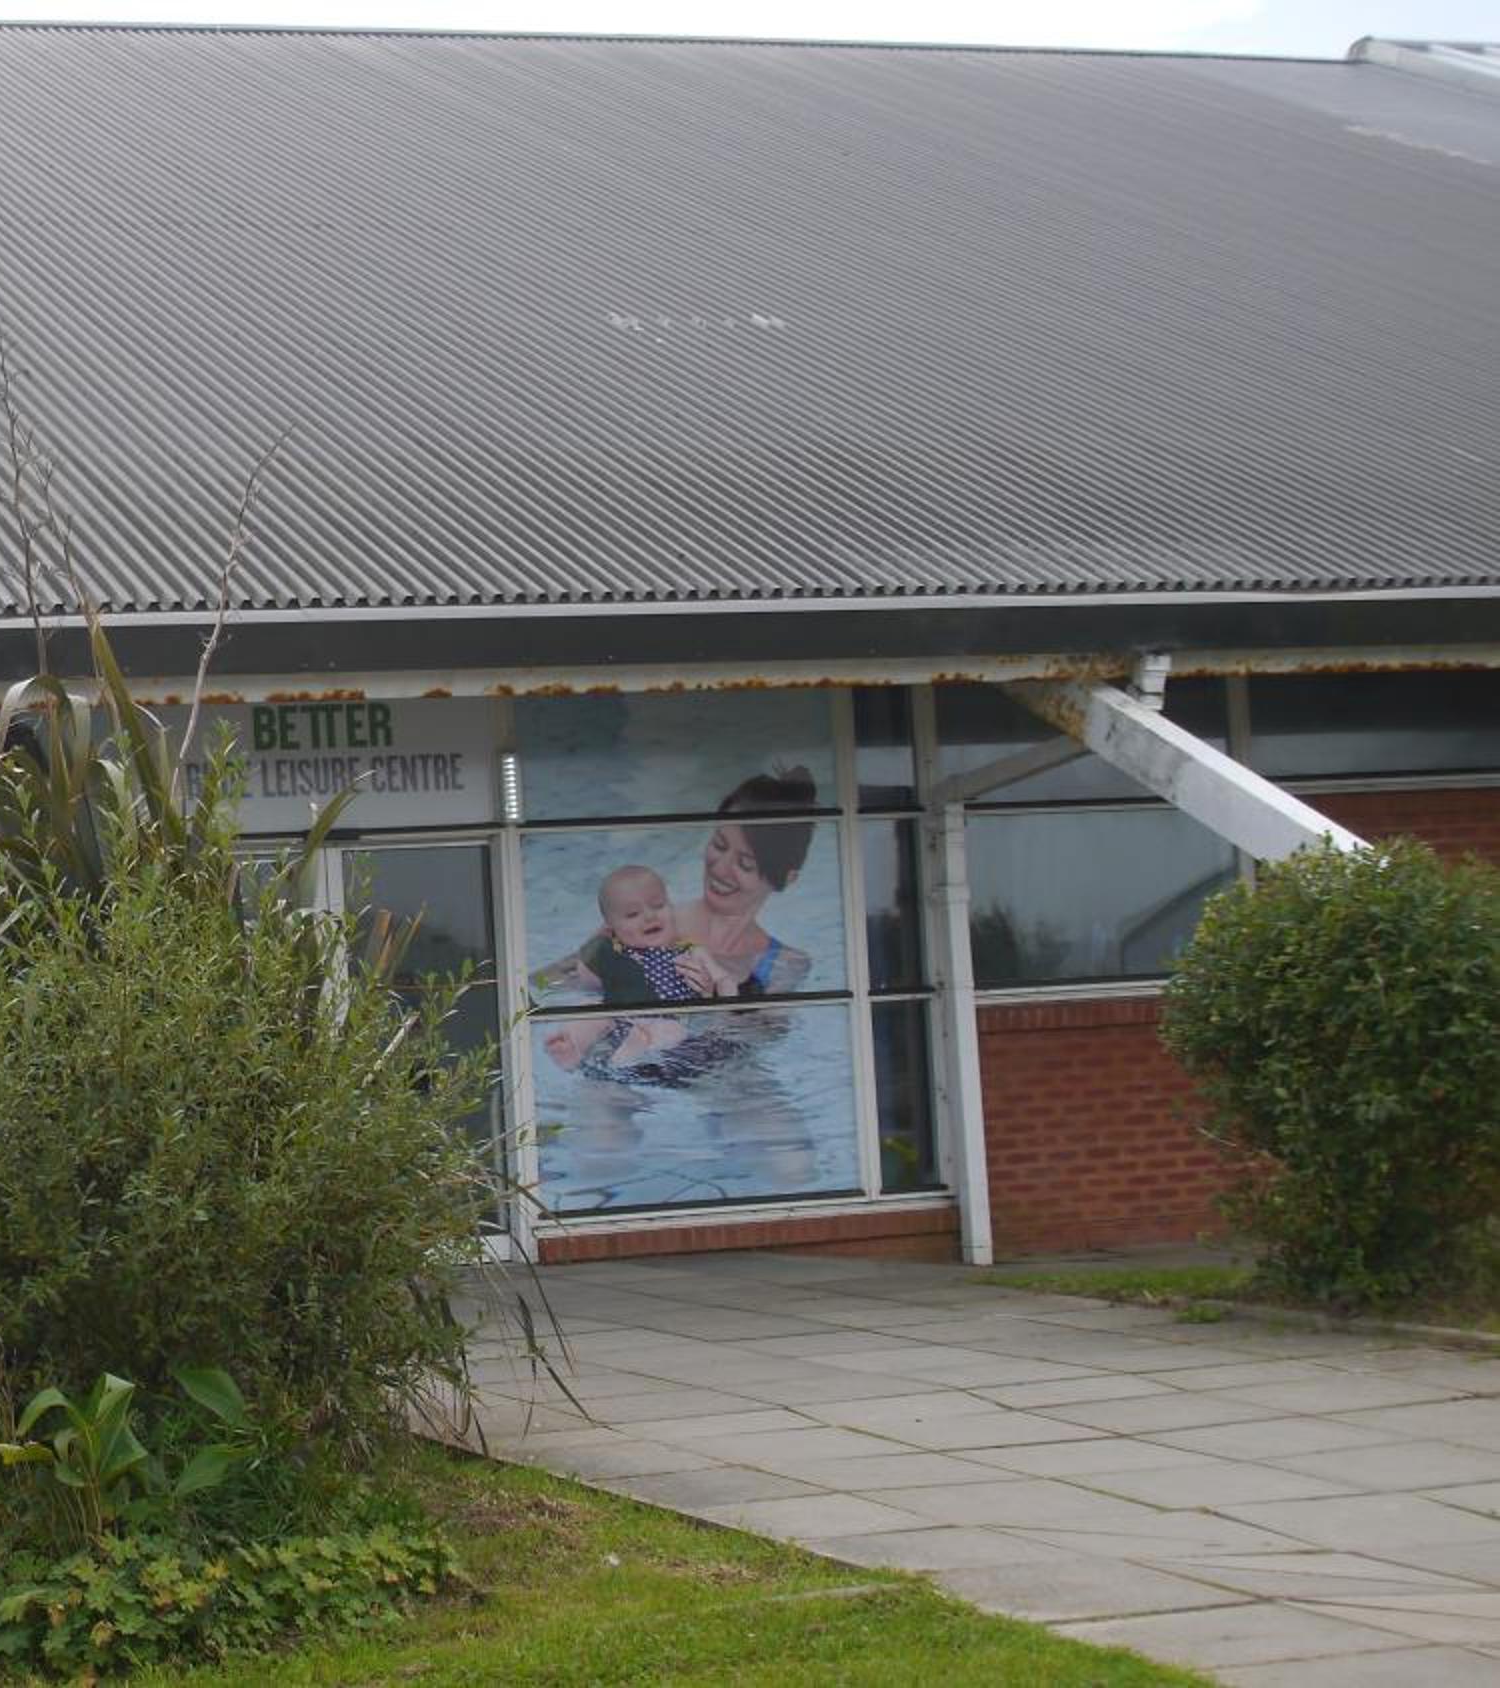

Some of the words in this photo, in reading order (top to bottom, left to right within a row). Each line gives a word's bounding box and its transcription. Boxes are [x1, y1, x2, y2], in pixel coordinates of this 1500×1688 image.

[252, 702, 393, 751] BETTER
[261, 757, 360, 798] LEISURE
[372, 754, 465, 793] CENTRE
